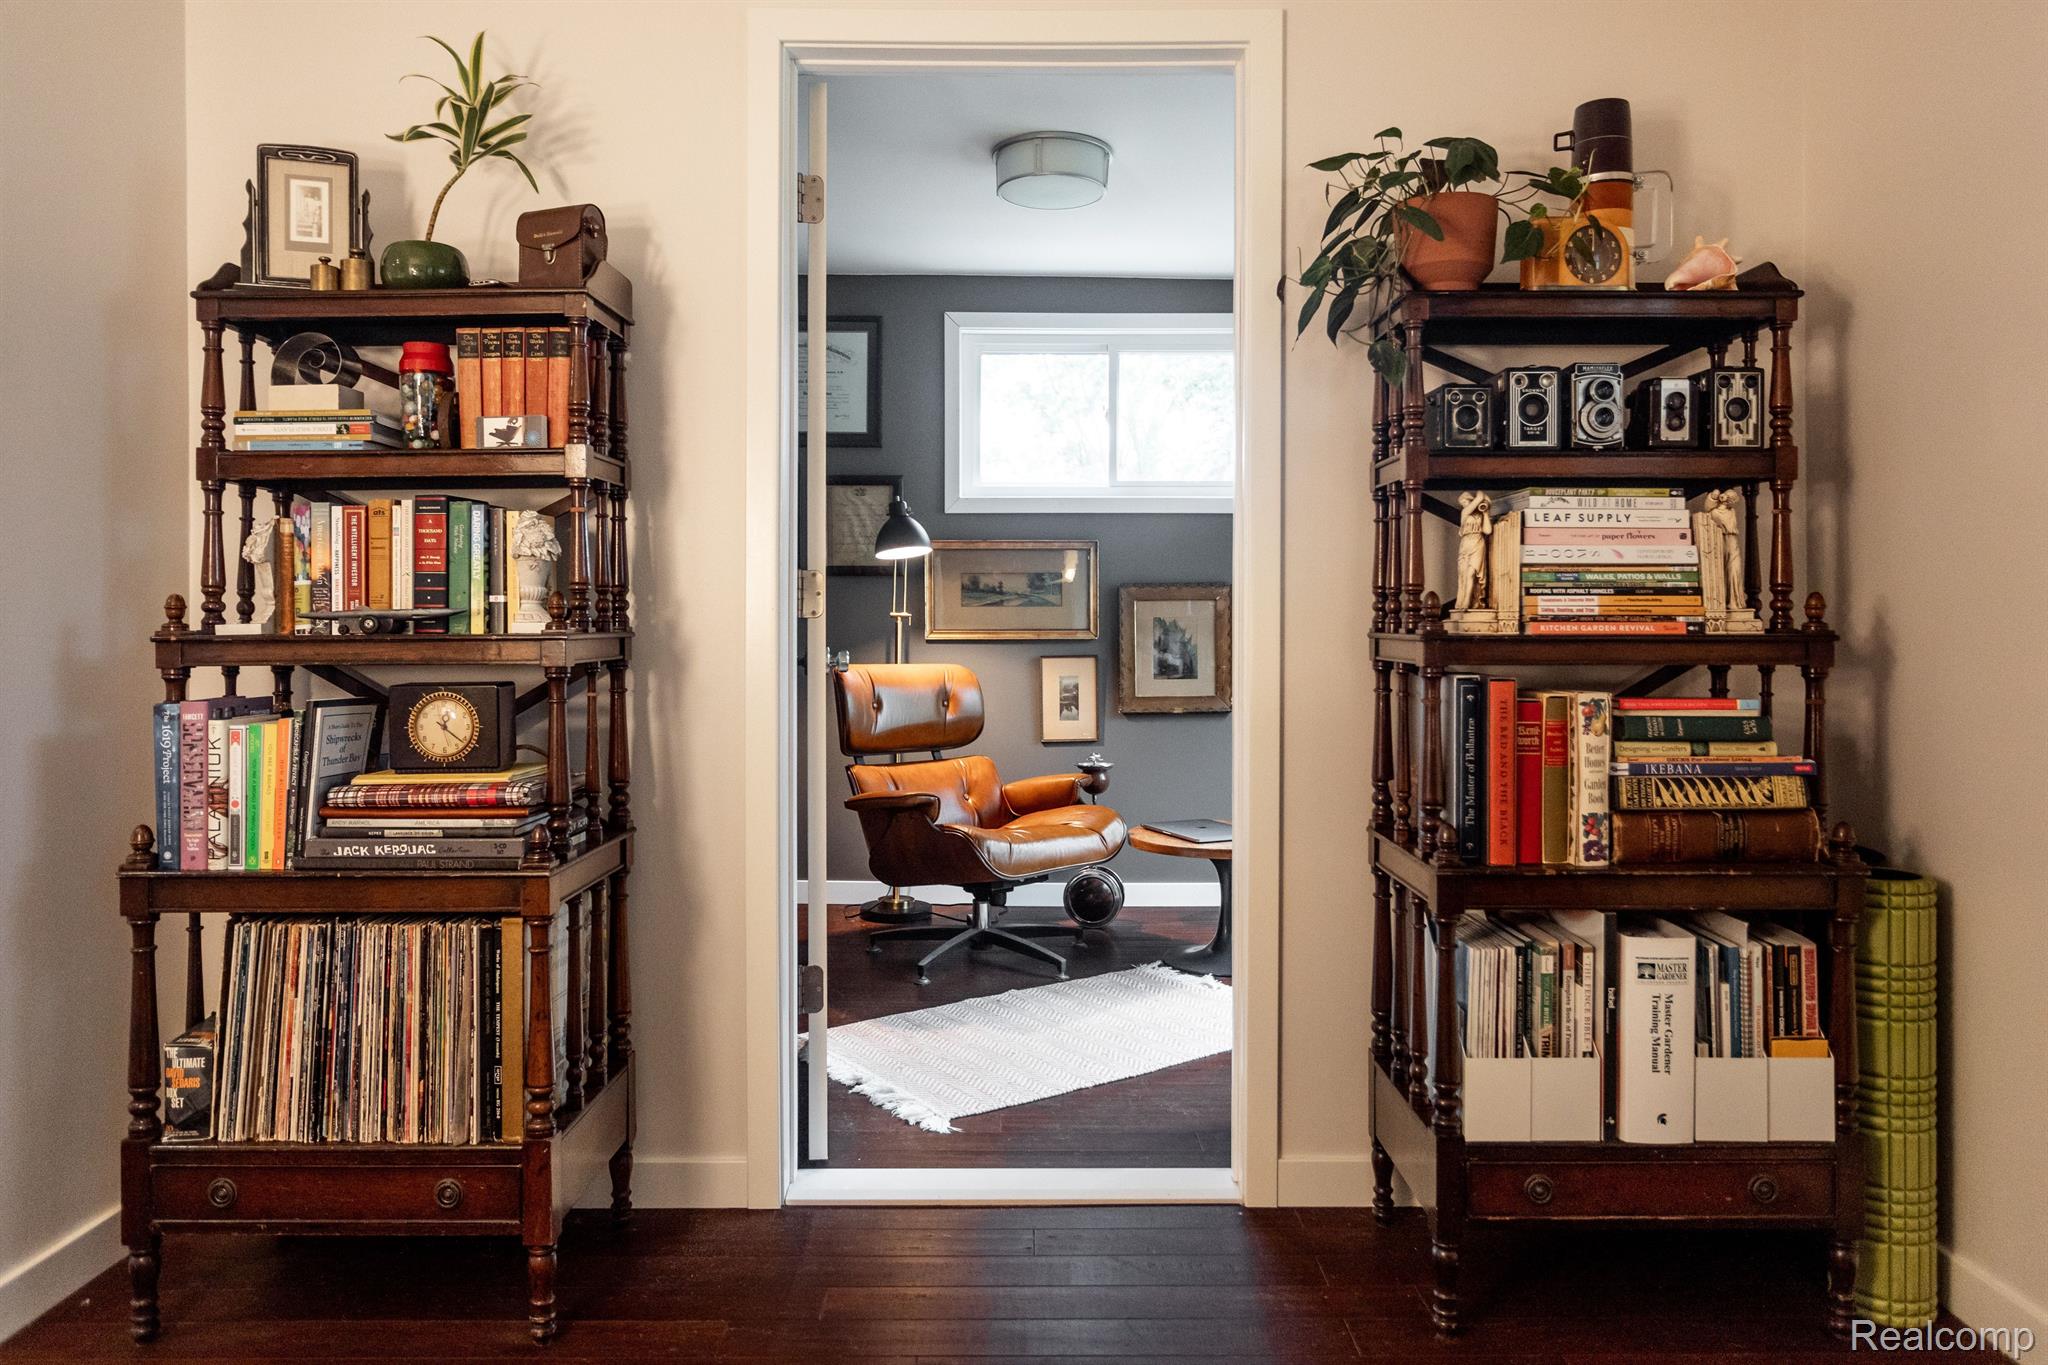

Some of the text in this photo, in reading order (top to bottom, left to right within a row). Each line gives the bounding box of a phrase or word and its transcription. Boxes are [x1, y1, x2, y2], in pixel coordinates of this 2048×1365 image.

[1577, 498, 1598, 507] WILD
[1615, 498, 1638, 508] HOME
[1534, 513, 1571, 522] LEAF
[1578, 513, 1631, 523] SUPPLY
[1626, 530, 1656, 540] flowers
[472, 510, 481, 580] DARING GREATLY
[160, 725, 173, 748] 1619
[326, 732, 362, 745] Shipwrecks
[339, 743, 347, 753] of
[1585, 742, 1605, 754] Better
[1620, 744, 1687, 753] Designing Conifers
[322, 753, 361, 767] Thunder Bay
[1584, 757, 1606, 769] Homes
[160, 749, 172, 784] Project
[1465, 762, 1475, 773] of
[1500, 699, 1509, 846] THE RED AND THE BLACK
[1645, 764, 1702, 774] IKEBANA
[1465, 774, 1475, 806] Master
[1588, 792, 1604, 804] Book
[1465, 808, 1475, 827] The
[333, 846, 370, 857] JACK
[374, 844, 436, 856] KEROUAC
[417, 860, 474, 869] PAUL STRAND
[1656, 963, 1688, 973] MASTER
[1650, 993, 1661, 1074] Training Manual
[1663, 993, 1674, 1076] Master Gardener
[165, 1047, 178, 1059] THE
[171, 1057, 206, 1069] ULTIMATE
[171, 1077, 201, 1089] SEDARIS
[171, 1097, 184, 1108] SET
